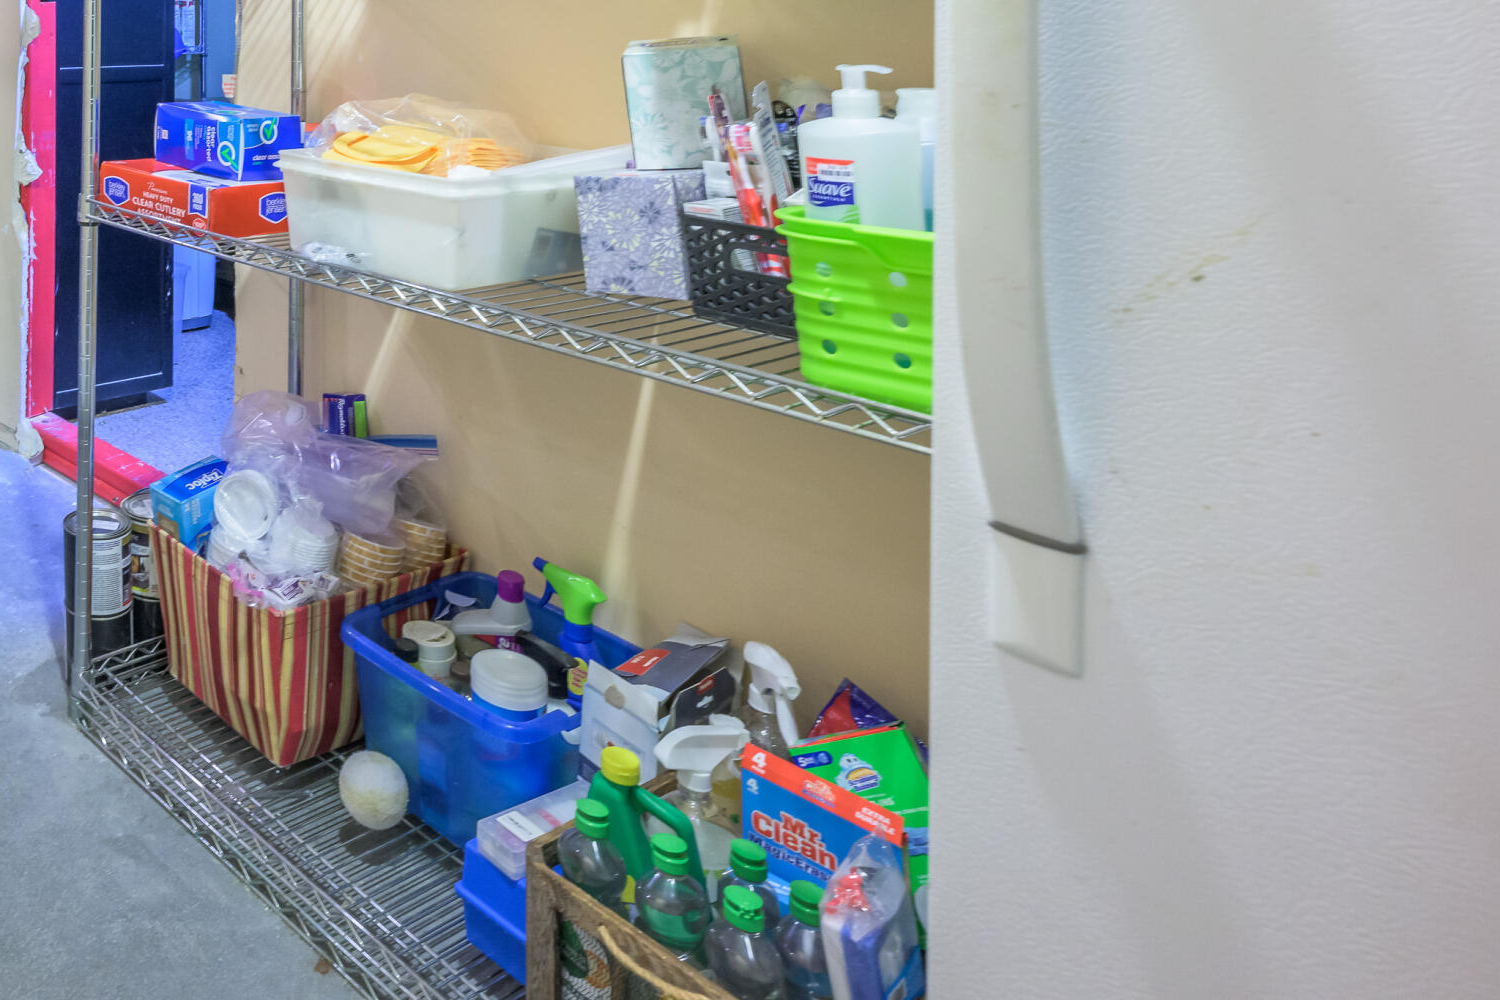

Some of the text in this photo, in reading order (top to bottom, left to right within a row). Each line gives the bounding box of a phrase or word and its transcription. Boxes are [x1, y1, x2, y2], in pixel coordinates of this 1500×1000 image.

[808, 177, 853, 197] Suave
[131, 196, 154, 209] CLEAR
[154, 202, 187, 217] CUTLERY
[142, 191, 174, 204] HEAVY DUTY
[185, 469, 223, 491] Ziploc
[751, 752, 767, 768] 4
[861, 807, 891, 825] EXTRA
[751, 809, 838, 872] Clean
[780, 811, 825, 850] Mr.
